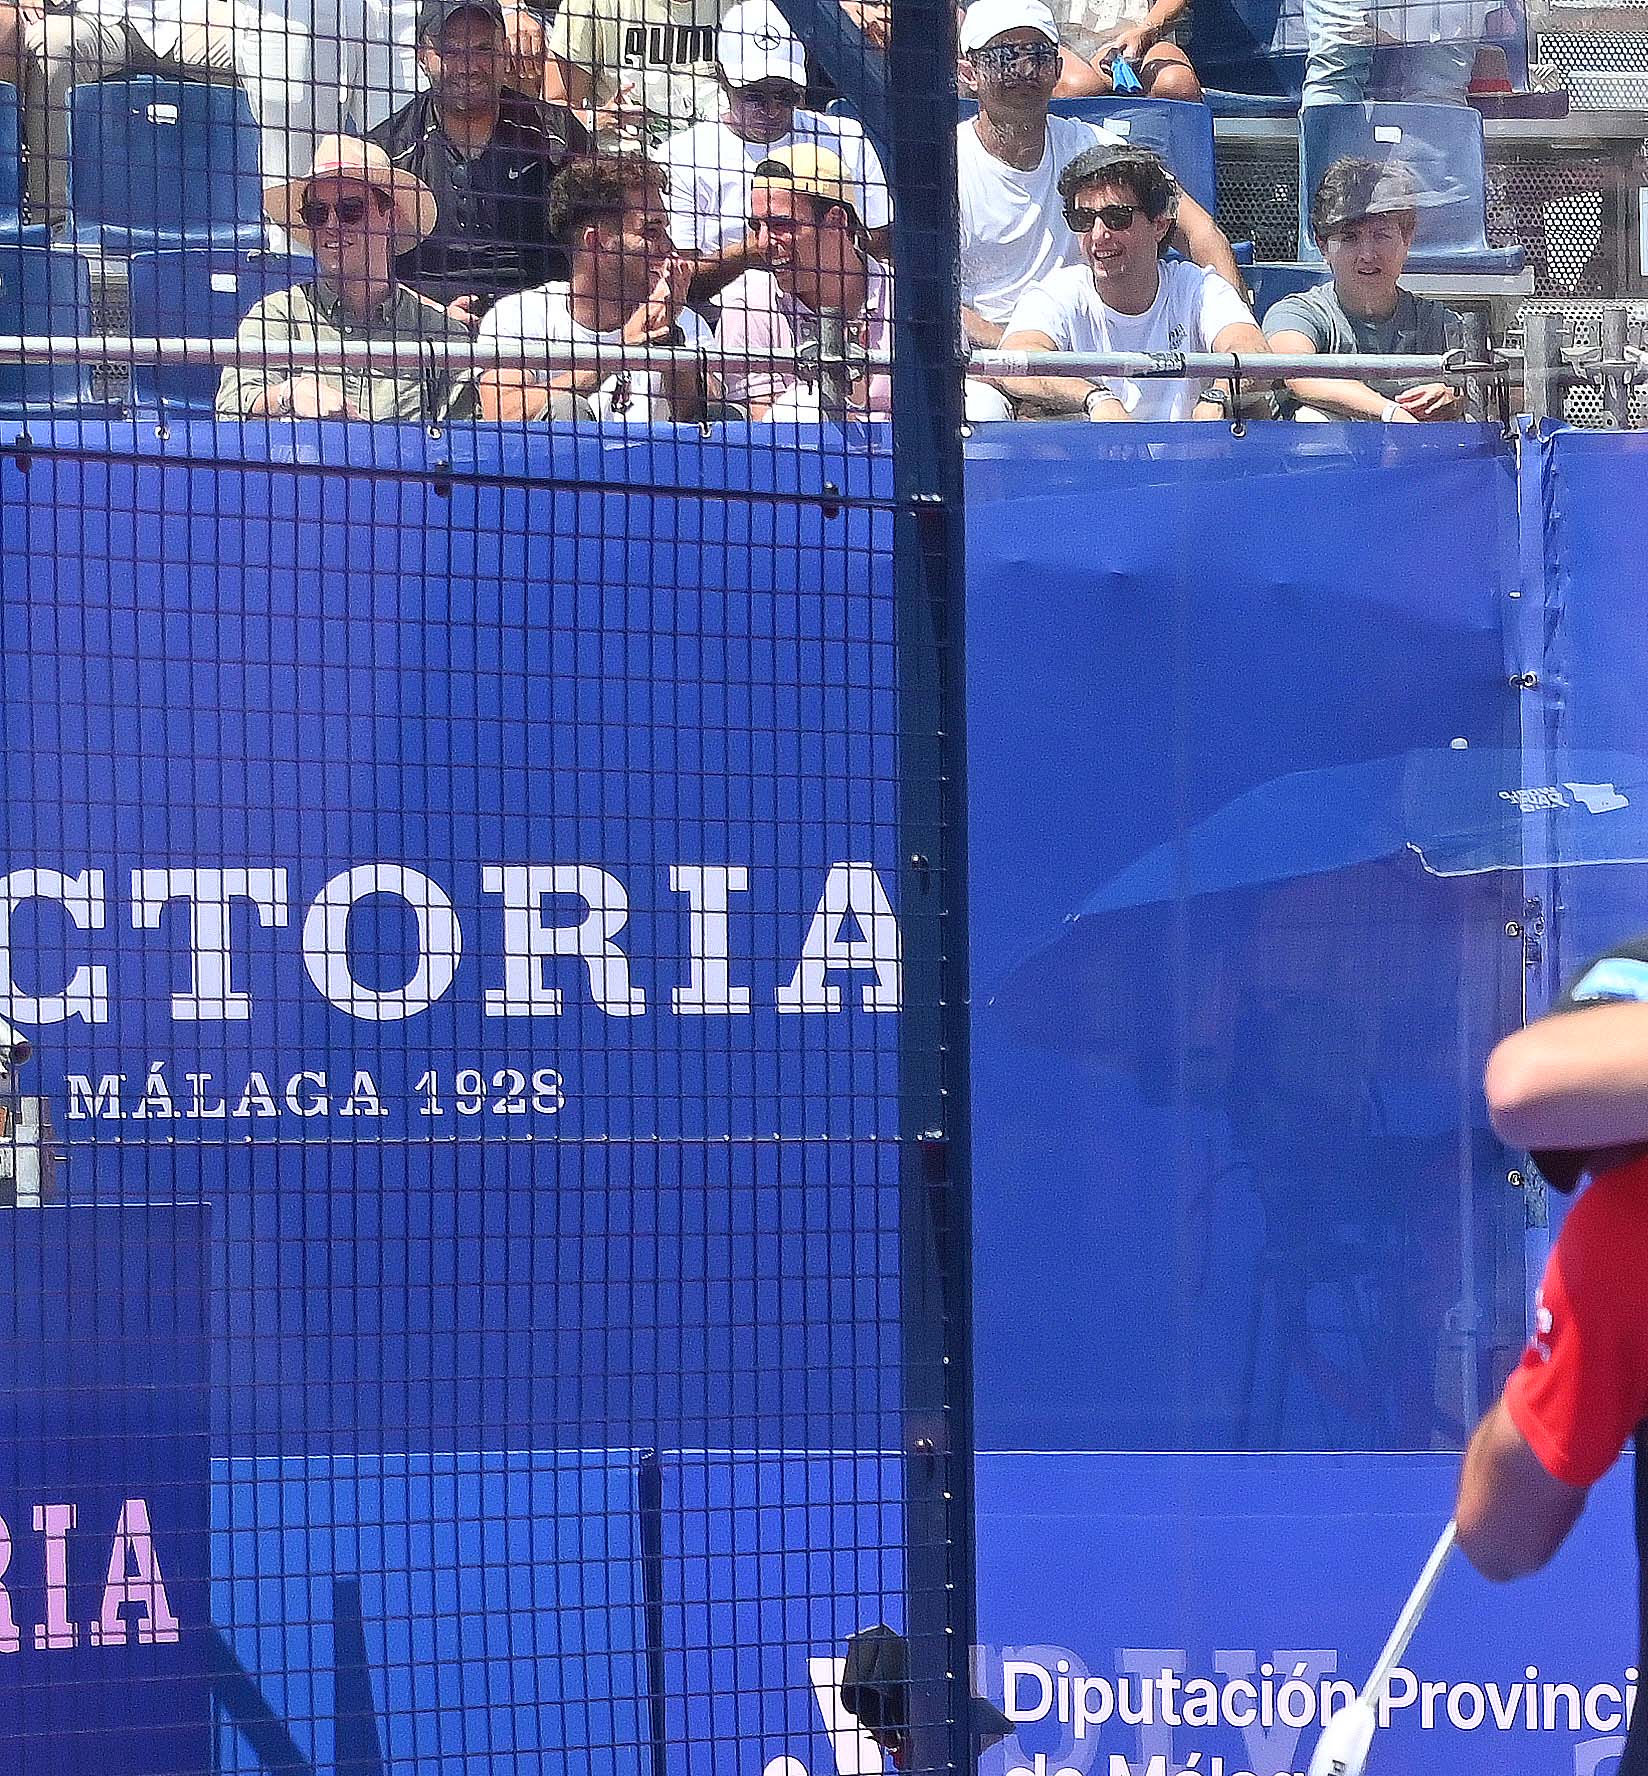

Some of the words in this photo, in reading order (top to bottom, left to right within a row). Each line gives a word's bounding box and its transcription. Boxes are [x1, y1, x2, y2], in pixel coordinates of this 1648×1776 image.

[65, 1060, 388, 1121] MÁLAGA
[414, 1067, 566, 1117] 1928
[1003, 1659, 1357, 1740] Diputación
